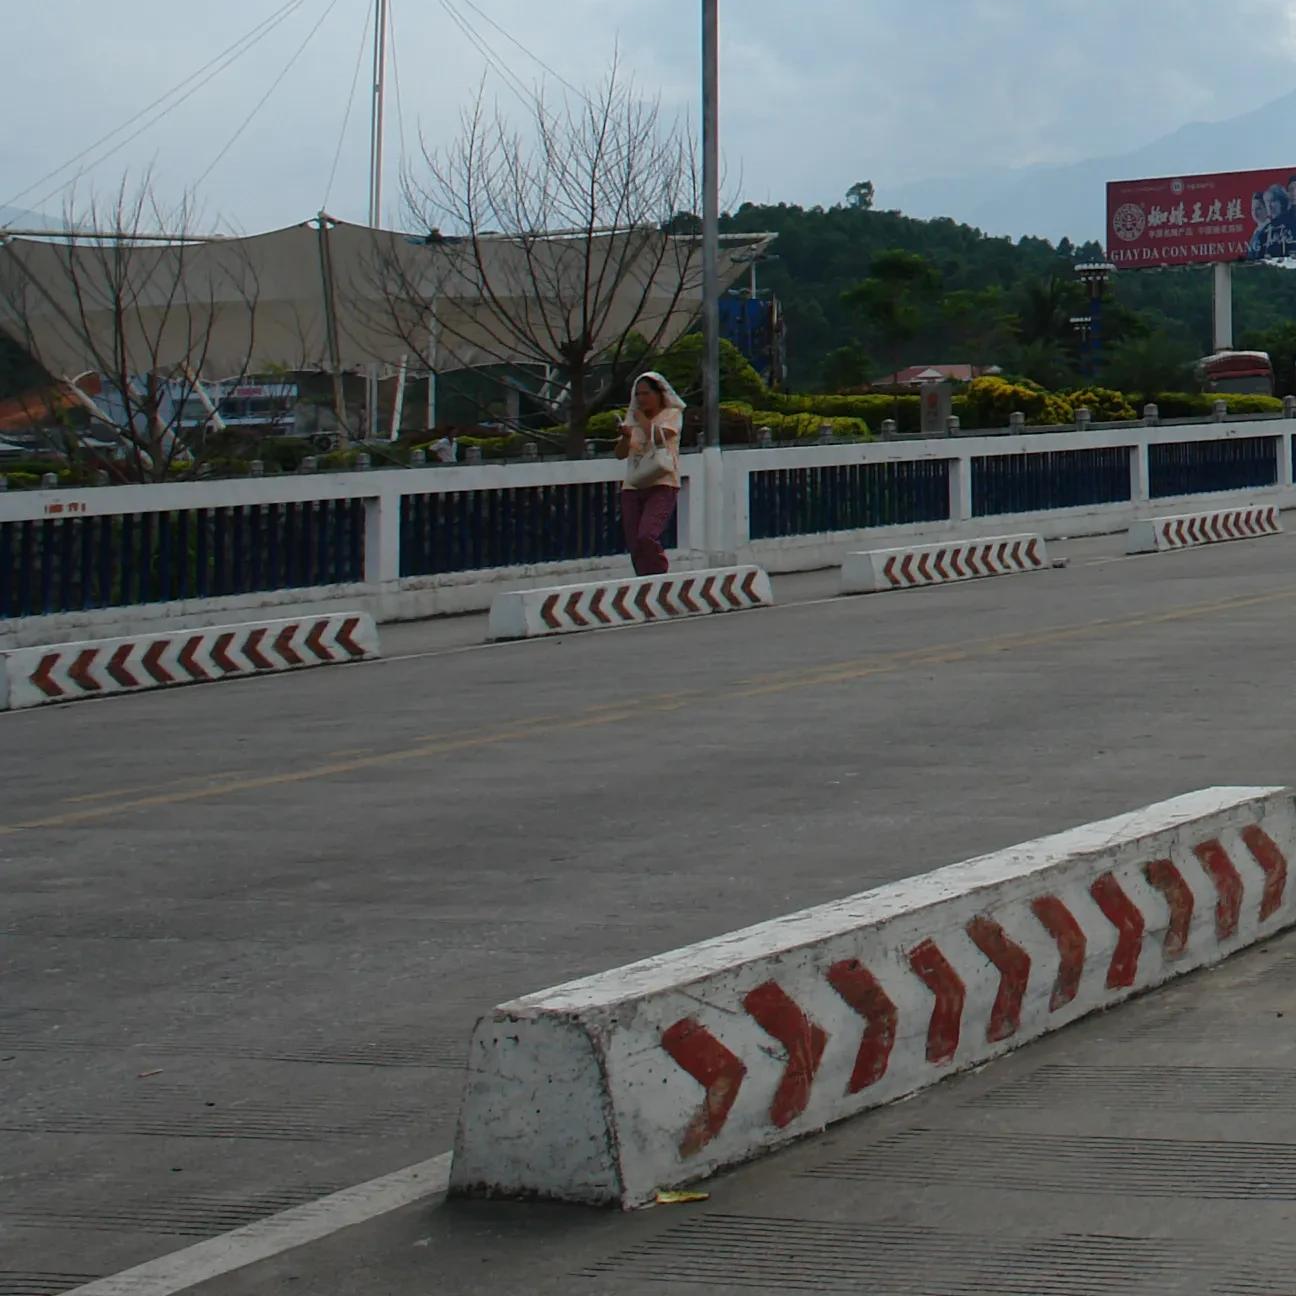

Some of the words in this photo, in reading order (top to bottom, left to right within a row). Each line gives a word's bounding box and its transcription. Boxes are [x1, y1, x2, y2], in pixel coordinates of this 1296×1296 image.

[1147, 197, 1246, 228] 蜘蛛王皮鞋
[1162, 244, 1190, 259] CON
